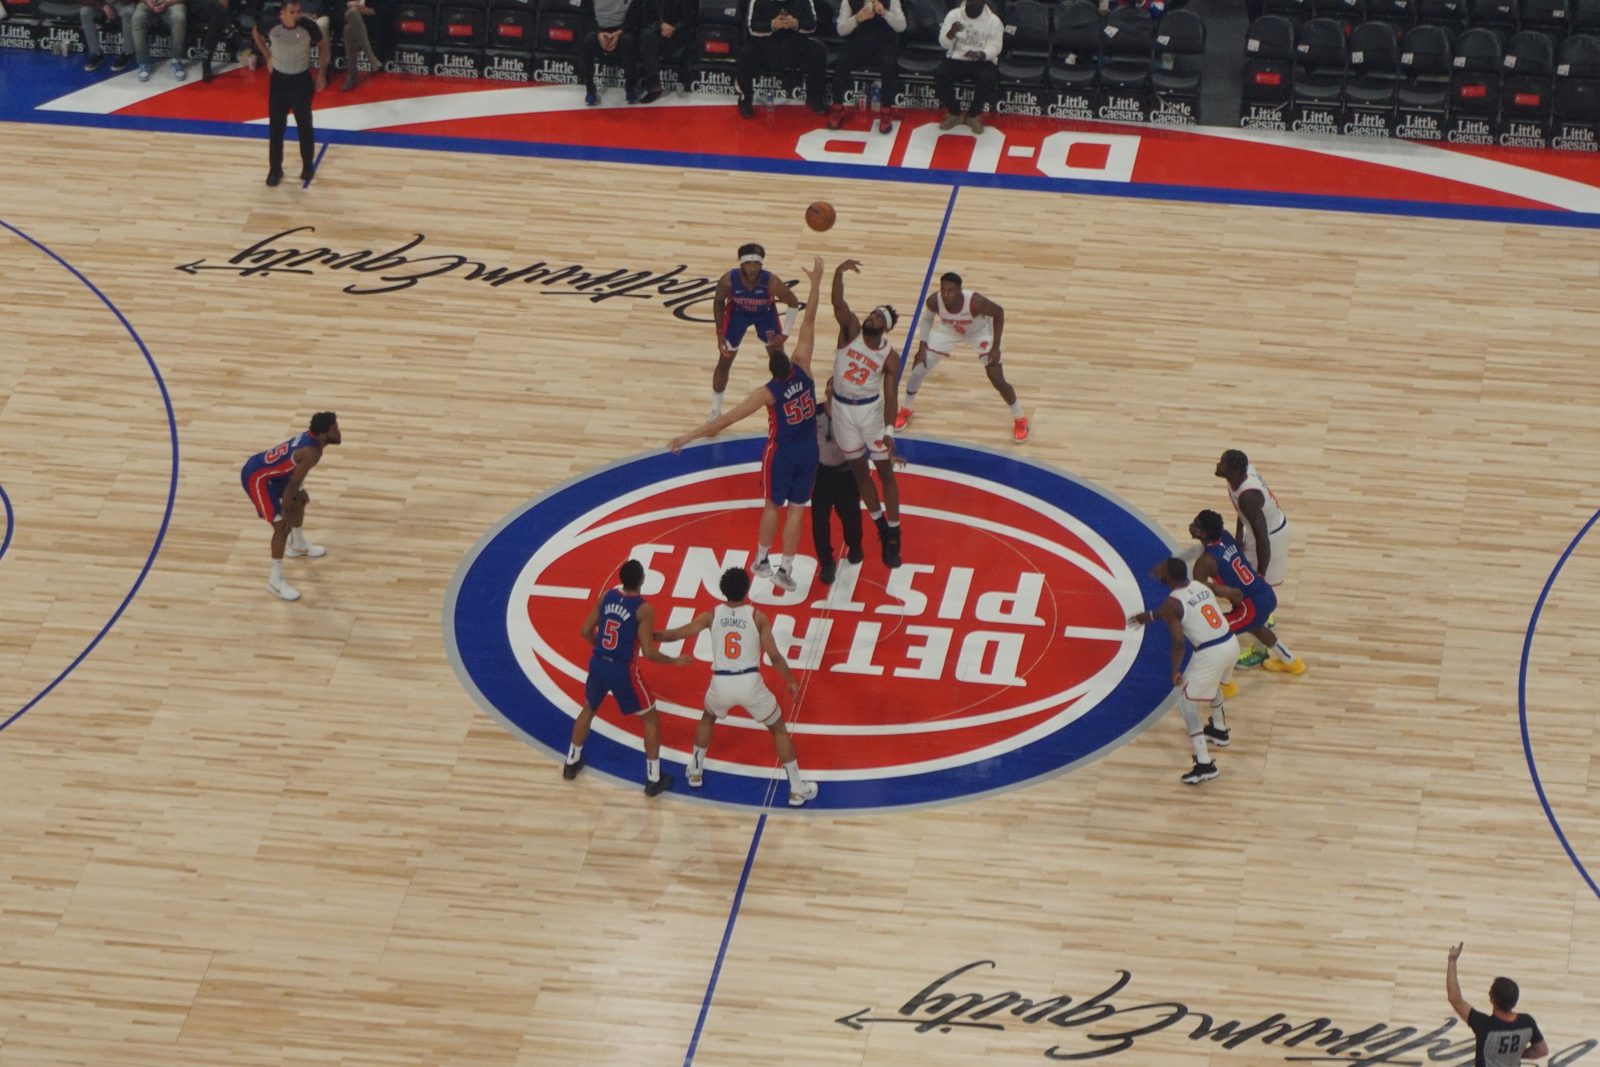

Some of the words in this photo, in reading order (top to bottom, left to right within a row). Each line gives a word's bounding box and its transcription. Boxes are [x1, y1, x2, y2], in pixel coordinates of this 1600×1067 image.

[1, 25, 31, 39] Little
[50, 28, 80, 42] Little
[0, 36, 35, 49] aesars
[394, 51, 424, 65] Little
[443, 54, 474, 68] Little
[493, 57, 524, 71] Little
[385, 61, 429, 75] Caesars
[434, 63, 478, 78] Caesars
[484, 66, 528, 82] Caesars
[543, 60, 574, 75] Little
[533, 69, 578, 85] Caesars
[701, 71, 731, 85] Little
[691, 81, 735, 95] Caesars
[1006, 91, 1037, 105] Little
[1057, 94, 1088, 109] Little
[1108, 97, 1139, 111] Little
[996, 100, 1041, 116] Caesars
[1047, 104, 1092, 119] Caesars
[1099, 106, 1143, 121] Caesars
[1240, 116, 1286, 131] Caesars
[1302, 110, 1333, 125] Little
[1354, 113, 1385, 128] Little
[1406, 115, 1437, 130] Little
[1292, 120, 1338, 135] Caesars
[1344, 123, 1389, 138] Caesars
[1396, 125, 1441, 140] Caesars
[1458, 120, 1489, 135] Little
[1509, 123, 1541, 138] Little
[1562, 127, 1594, 142] Little
[1448, 130, 1493, 145] Caesars
[1500, 133, 1545, 148] Caesars
[1552, 136, 1598, 151] Caesars
[795, 119, 1141, 182] D-UP
[228, 226, 467, 294] Equity
[843, 361, 870, 386] 23
[784, 390, 815, 425] 55
[1232, 556, 1255, 585] 6
[613, 544, 1047, 626] PISTONS
[604, 603, 631, 621] JACKSON
[1200, 604, 1223, 630] 8
[602, 619, 621, 650] 5
[638, 606, 1027, 686] DETRI
[724, 631, 742, 660] 6
[899, 960, 1188, 1060] Equity
[1499, 1034, 1520, 1055] 52
